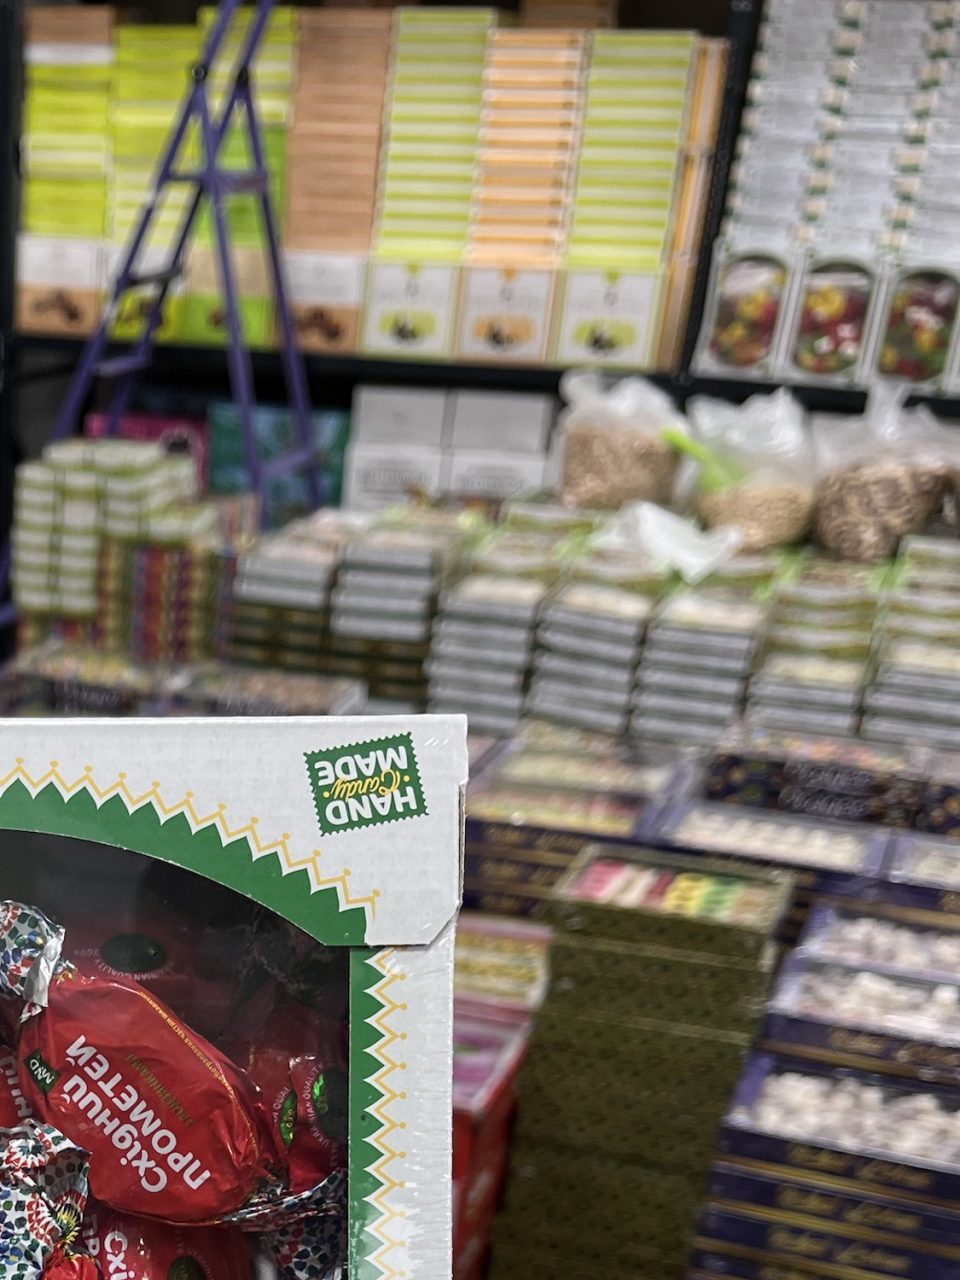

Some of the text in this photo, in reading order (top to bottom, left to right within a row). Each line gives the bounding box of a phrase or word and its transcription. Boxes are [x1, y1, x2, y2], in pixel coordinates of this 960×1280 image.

[314, 745, 409, 787] MADE
[329, 768, 401, 800] Candy
[325, 786, 418, 826] HAND
[59, 1074, 169, 1193] Східний
[65, 1034, 211, 1191] ПРОМЕТЕЙ
